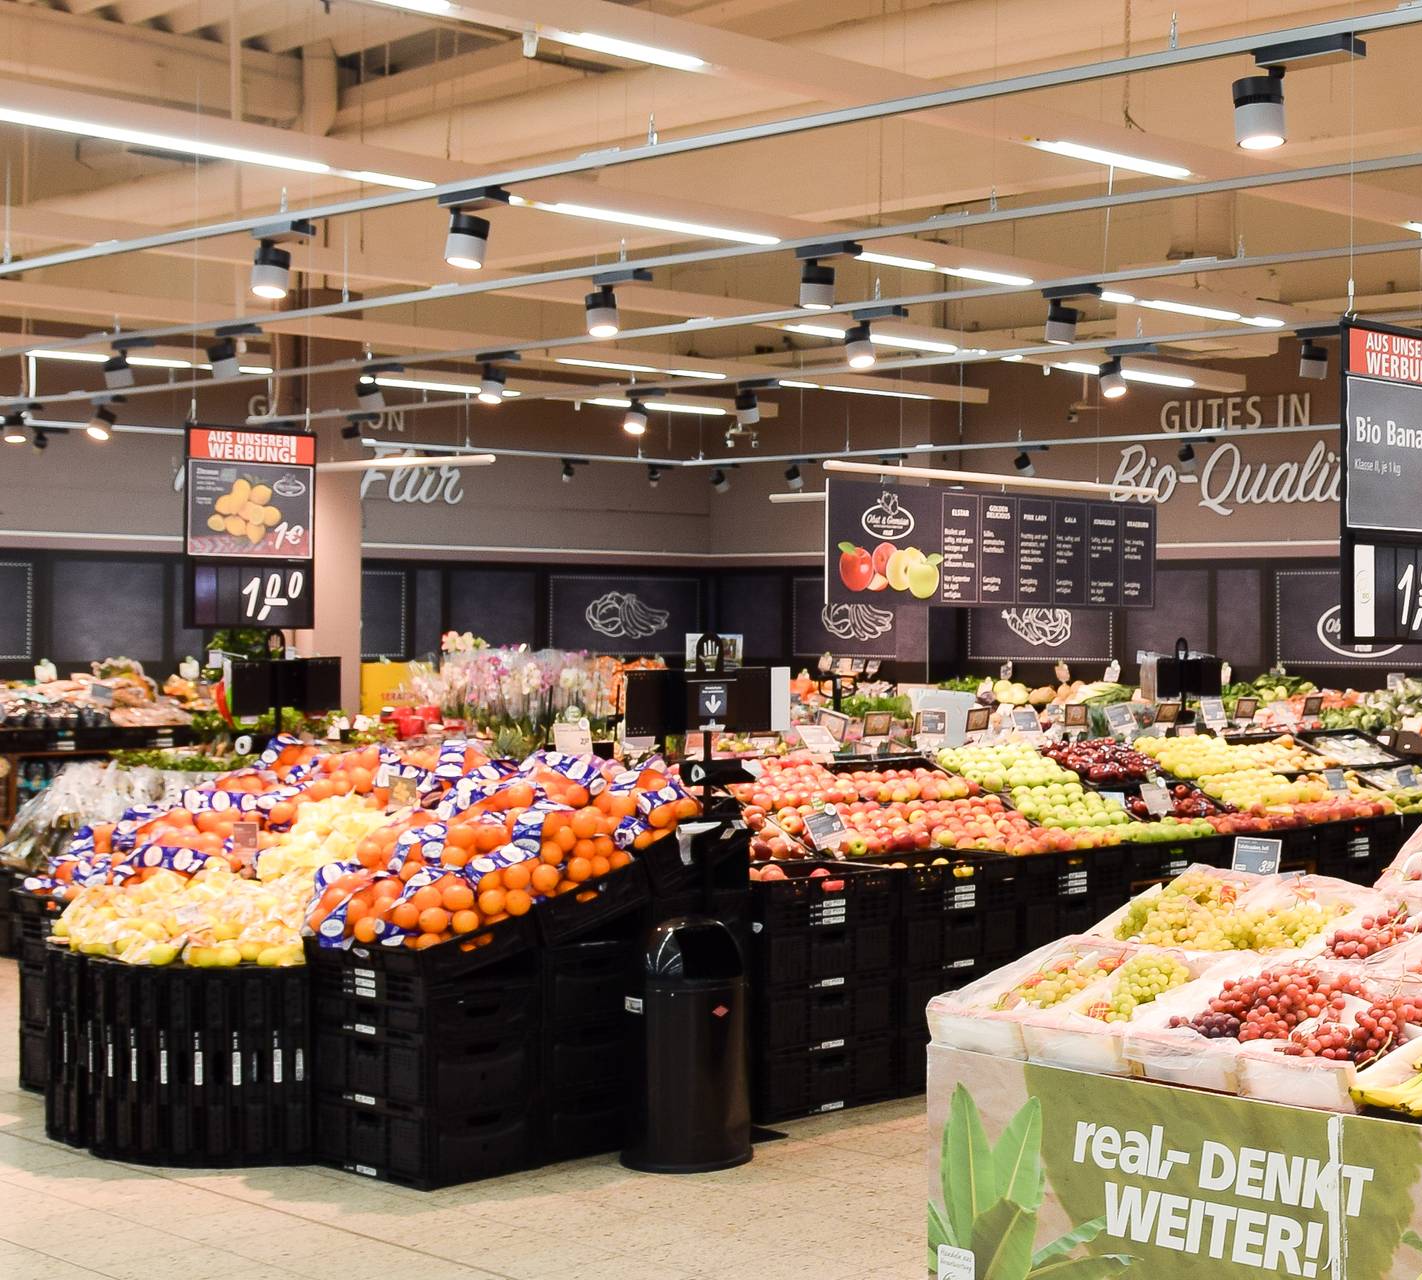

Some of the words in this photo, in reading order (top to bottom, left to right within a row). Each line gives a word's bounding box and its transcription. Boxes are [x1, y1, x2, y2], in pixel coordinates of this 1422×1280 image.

[1366, 333, 1388, 352] AUS
[1160, 395, 1262, 433] GUTES
[1277, 392, 1310, 427] IN
[1355, 416, 1381, 444] Bio
[208, 430, 232, 443] AUS
[237, 432, 290, 447] UNSERER
[208, 440, 297, 464] WERBUNG!
[361, 446, 464, 505] Flur
[1109, 440, 1340, 515] Bio-Quali
[1354, 458, 1373, 471] Klasse
[274, 521, 304, 550] 1€
[242, 571, 303, 621] 1,00
[1072, 1121, 1191, 1180] real,-
[1198, 1140, 1375, 1217] DENKT
[1104, 1181, 1324, 1279] WEITER!
